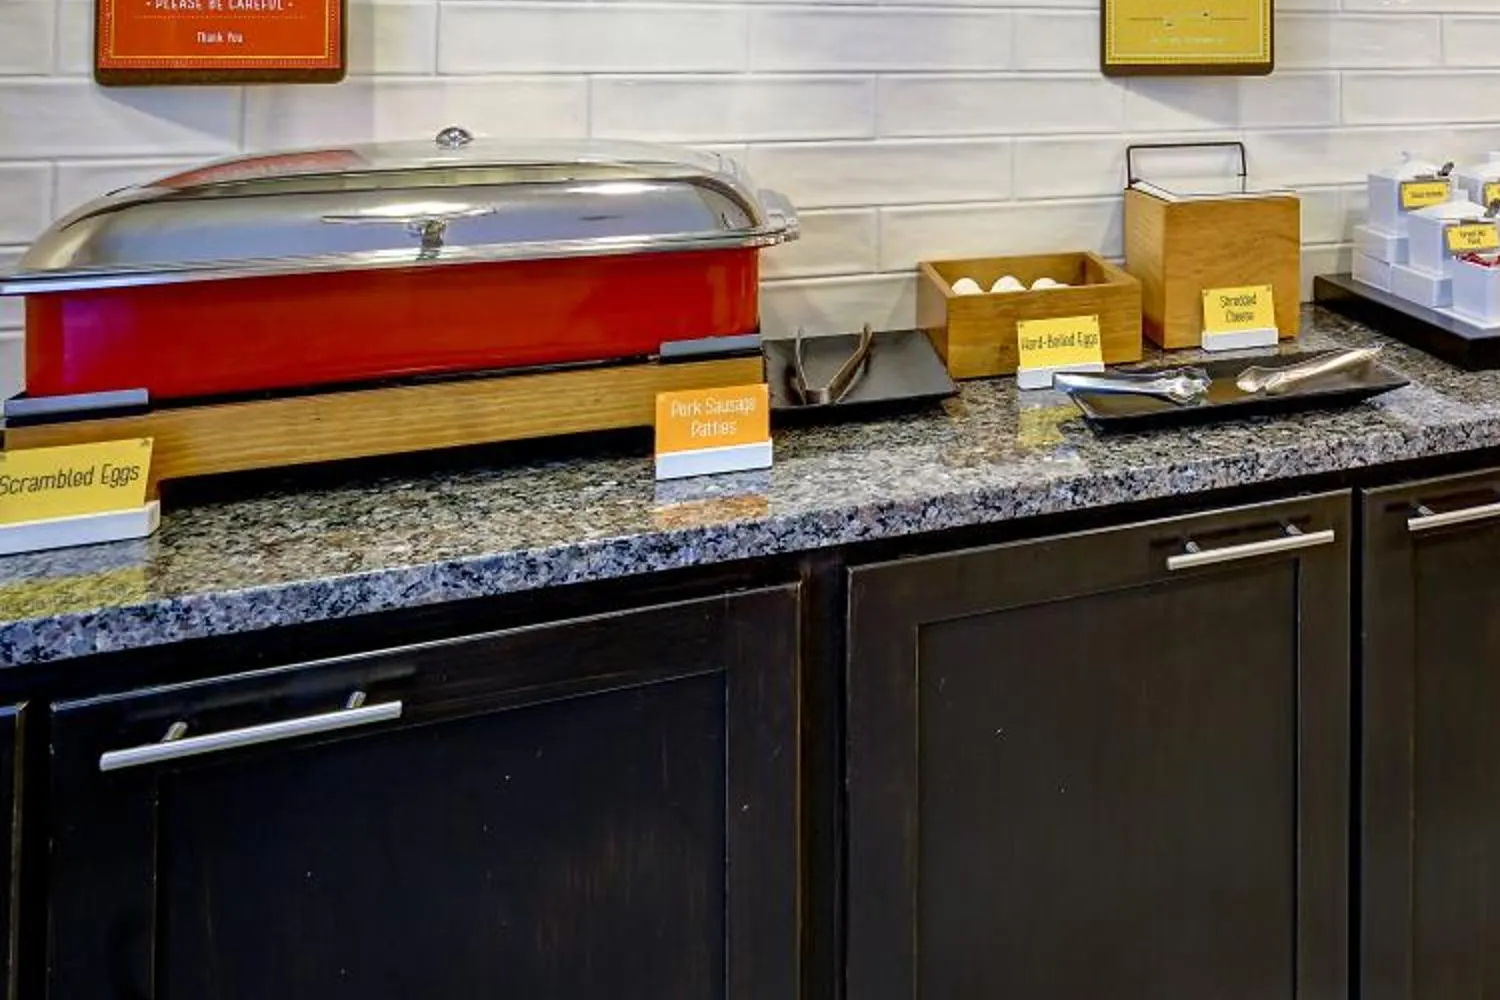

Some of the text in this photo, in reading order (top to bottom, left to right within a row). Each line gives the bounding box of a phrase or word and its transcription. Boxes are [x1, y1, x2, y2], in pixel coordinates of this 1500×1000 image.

[197, 31, 243, 43] Thank You
[671, 396, 756, 418] Pork Sausage
[691, 419, 737, 438] Patties
[0, 463, 141, 496] Scrambled Eggs
